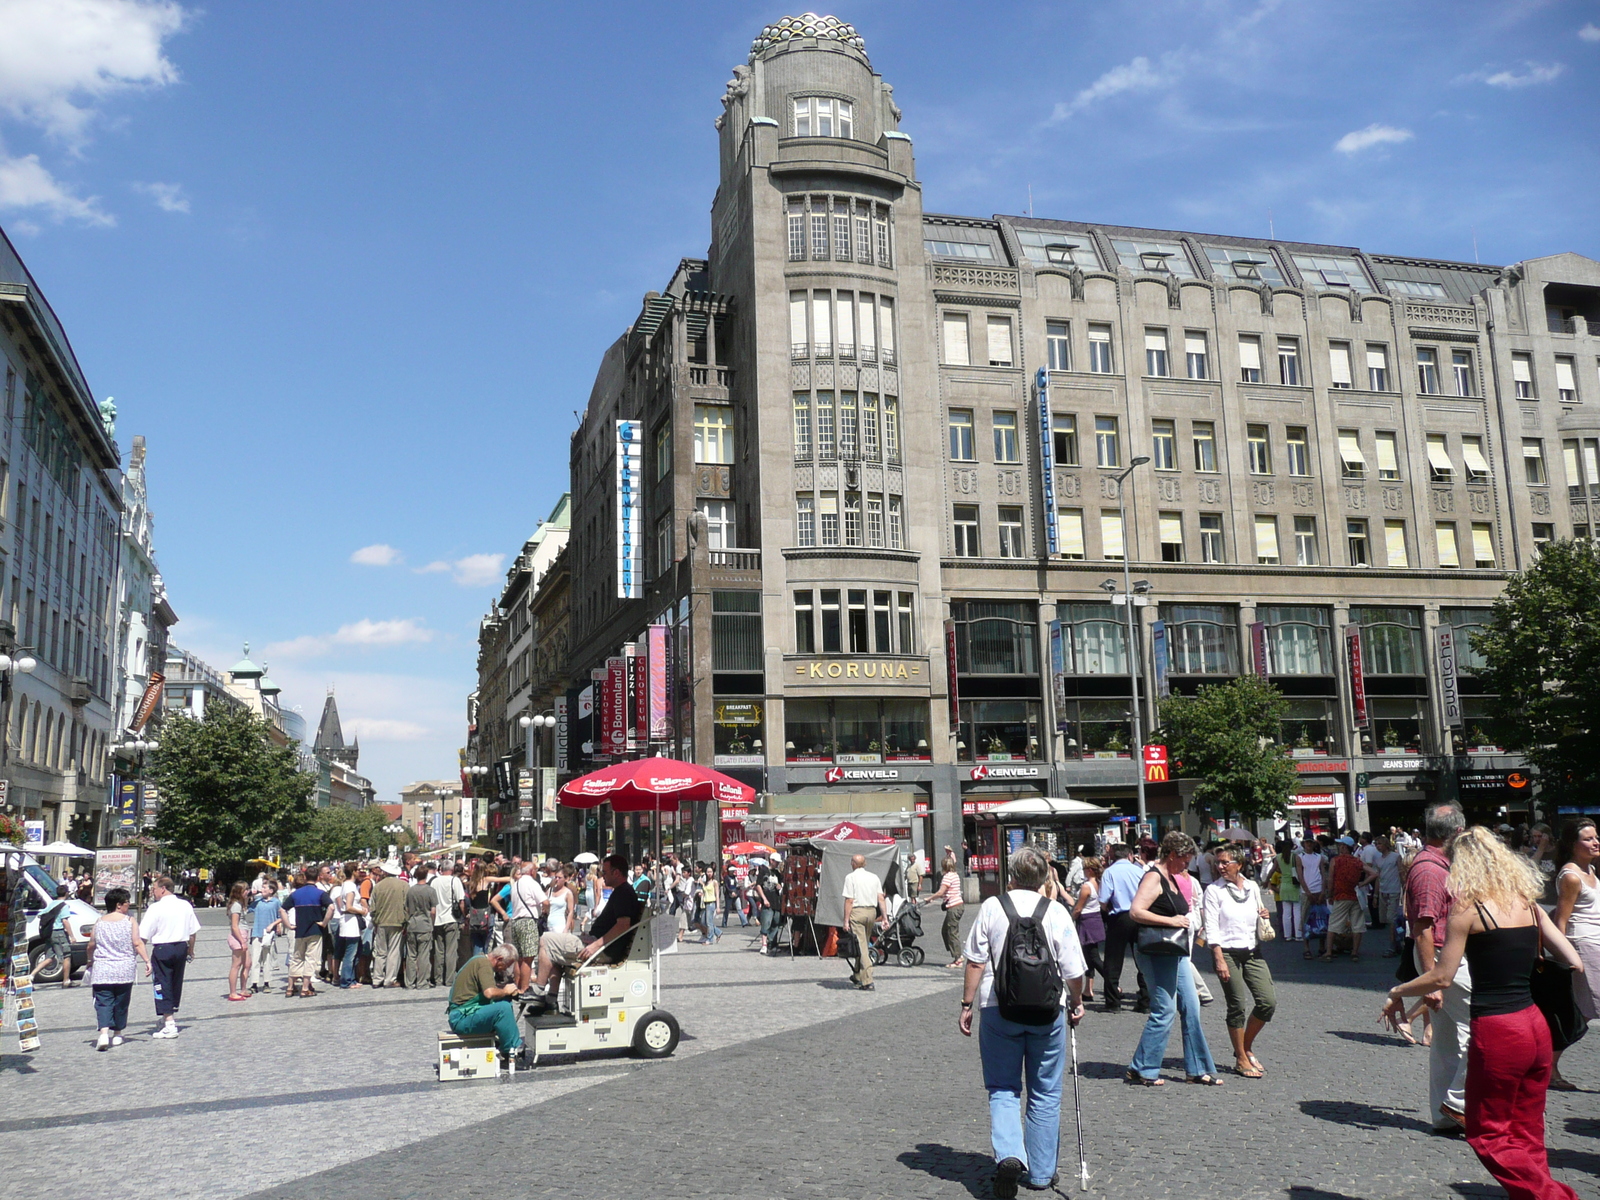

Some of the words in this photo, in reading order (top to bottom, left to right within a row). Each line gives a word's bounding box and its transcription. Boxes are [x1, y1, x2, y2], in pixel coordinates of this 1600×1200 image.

[621, 442, 632, 598] TECHNOEXPORT
[810, 662, 909, 679] KORUNA
[1353, 636, 1363, 700] COLOSEUM
[1441, 646, 1458, 718] swatch
[638, 657, 646, 722] COLOSEUM
[613, 669, 622, 728] Bontonland
[559, 715, 567, 769] swatch
[1295, 761, 1347, 772] ontonland
[1404, 760, 1424, 768] STORE
[844, 770, 898, 779] KENVELO
[988, 768, 1038, 776] KENVELO
[583, 778, 617, 787] Collonil
[650, 778, 692, 787] Collonil
[719, 782, 742, 795] Collonil
[1297, 795, 1332, 803] Bontonland
[963, 803, 975, 811] SALE
[722, 809, 734, 817] SALE
